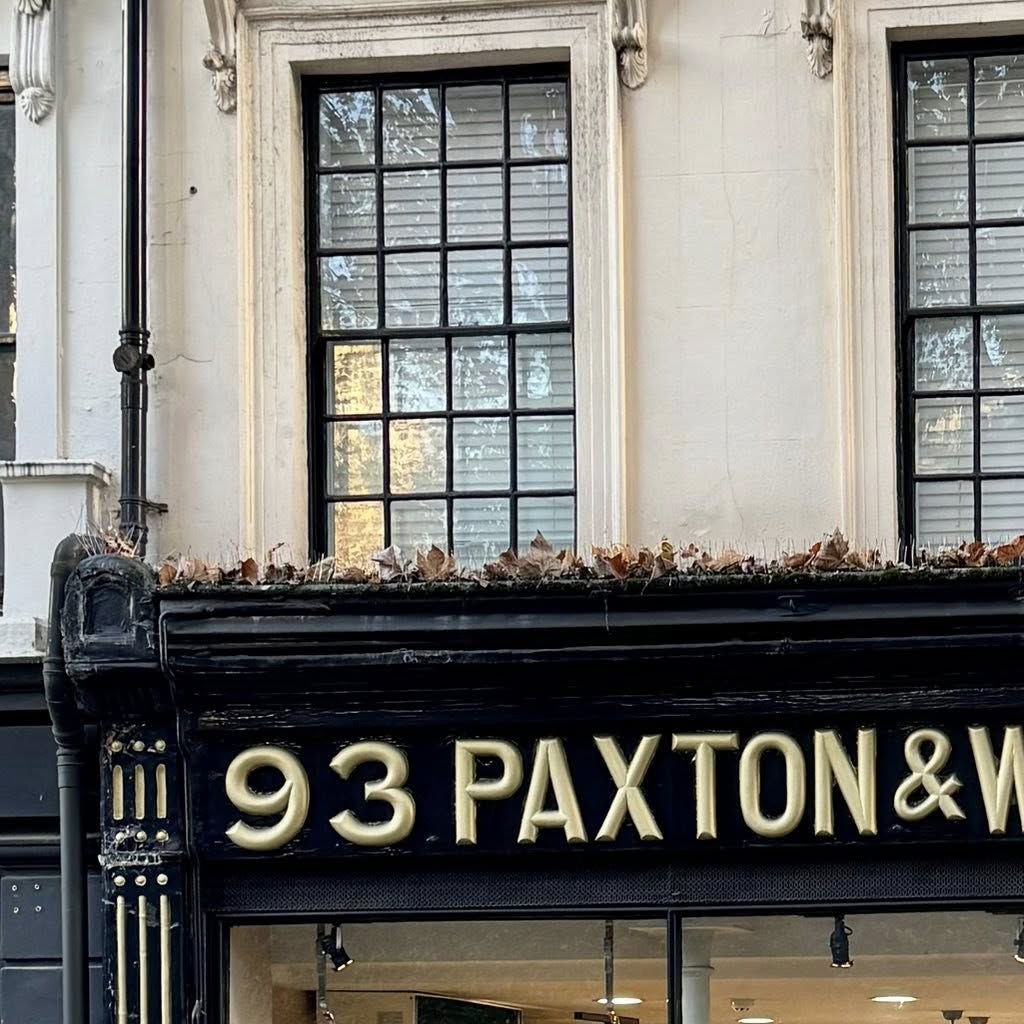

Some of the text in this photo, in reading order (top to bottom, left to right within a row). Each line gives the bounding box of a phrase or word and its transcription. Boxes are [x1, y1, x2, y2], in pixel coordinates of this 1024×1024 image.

[225, 741, 416, 850] 93
[455, 728, 878, 846] PAXTON
[894, 728, 967, 822] &
